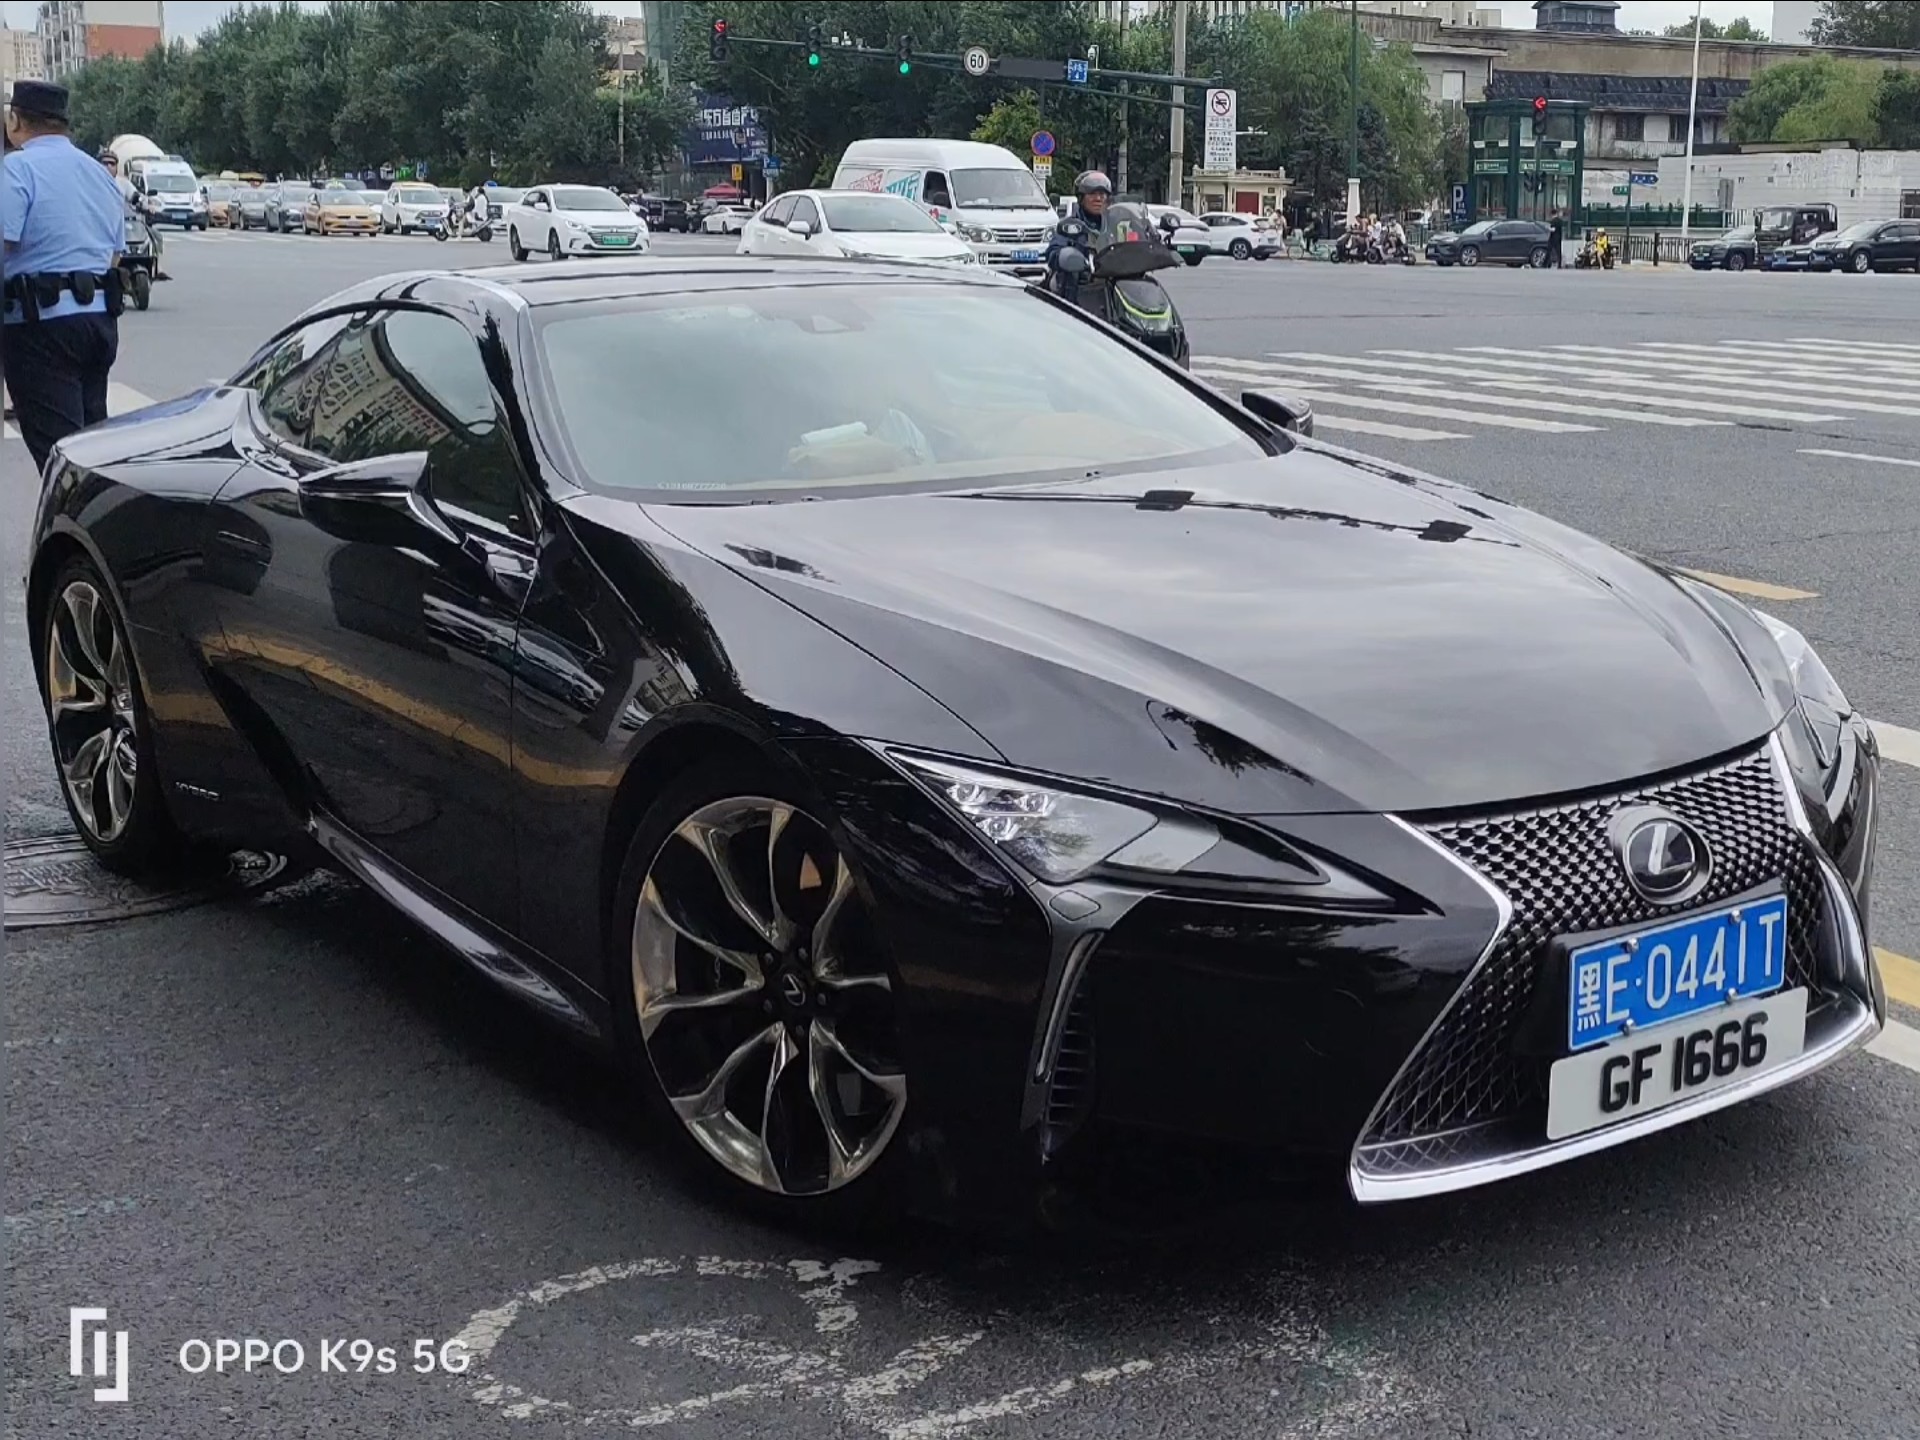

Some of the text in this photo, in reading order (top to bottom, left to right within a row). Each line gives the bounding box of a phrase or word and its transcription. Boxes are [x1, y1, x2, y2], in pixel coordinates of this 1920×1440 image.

[970, 53, 985, 69] 60
[1452, 185, 1464, 213] P
[1599, 1011, 1769, 1113] GF 1666
